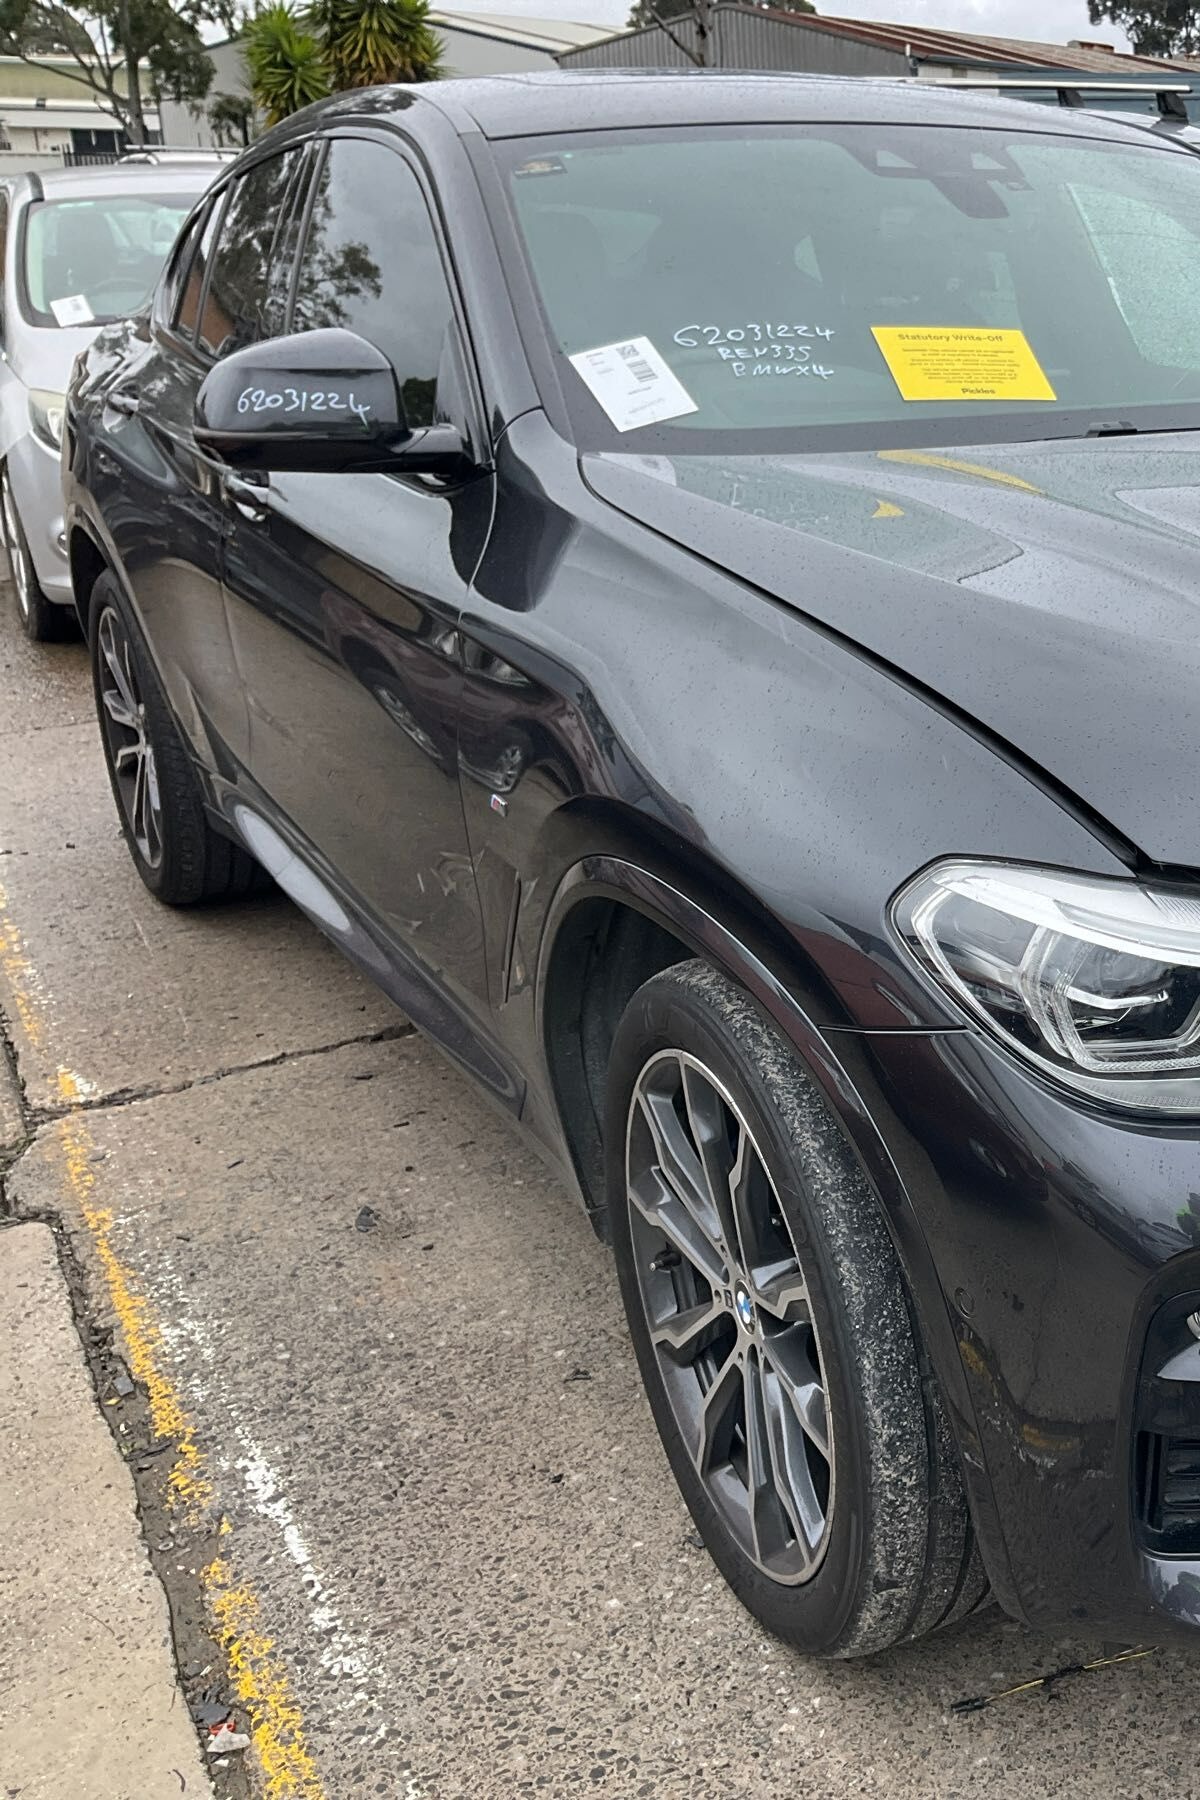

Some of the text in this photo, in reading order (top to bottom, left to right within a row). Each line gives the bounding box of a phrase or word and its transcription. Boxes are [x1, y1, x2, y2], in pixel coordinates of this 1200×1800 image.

[674, 324, 835, 347] 62031224
[898, 333, 1004, 342] Statutory Write-Off
[961, 387, 996, 395] Pickles
[238, 387, 371, 428] 62031224
